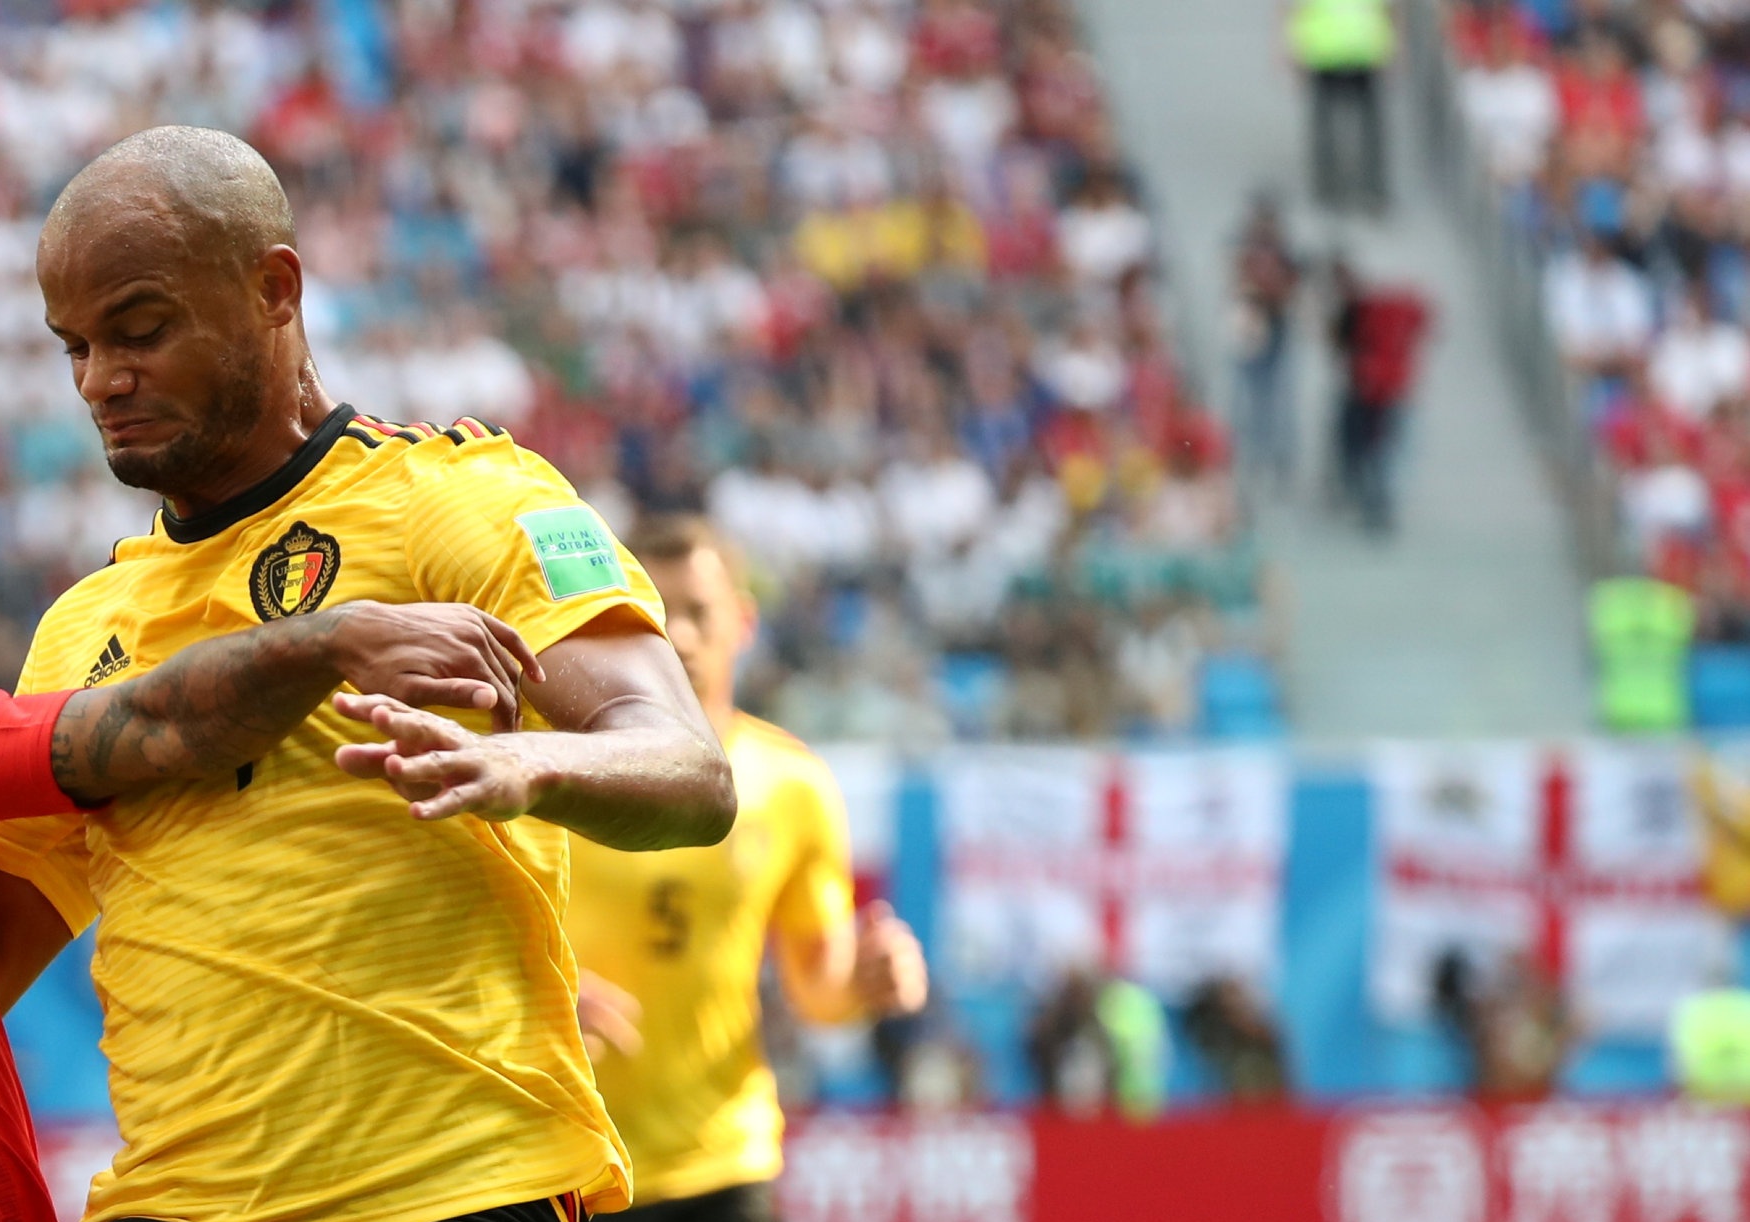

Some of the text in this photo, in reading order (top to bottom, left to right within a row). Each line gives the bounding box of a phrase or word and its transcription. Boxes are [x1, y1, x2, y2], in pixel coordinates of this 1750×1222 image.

[536, 529, 602, 544] LIVING
[540, 538, 607, 554] FOOTBALL
[84, 655, 131, 689] adidas
